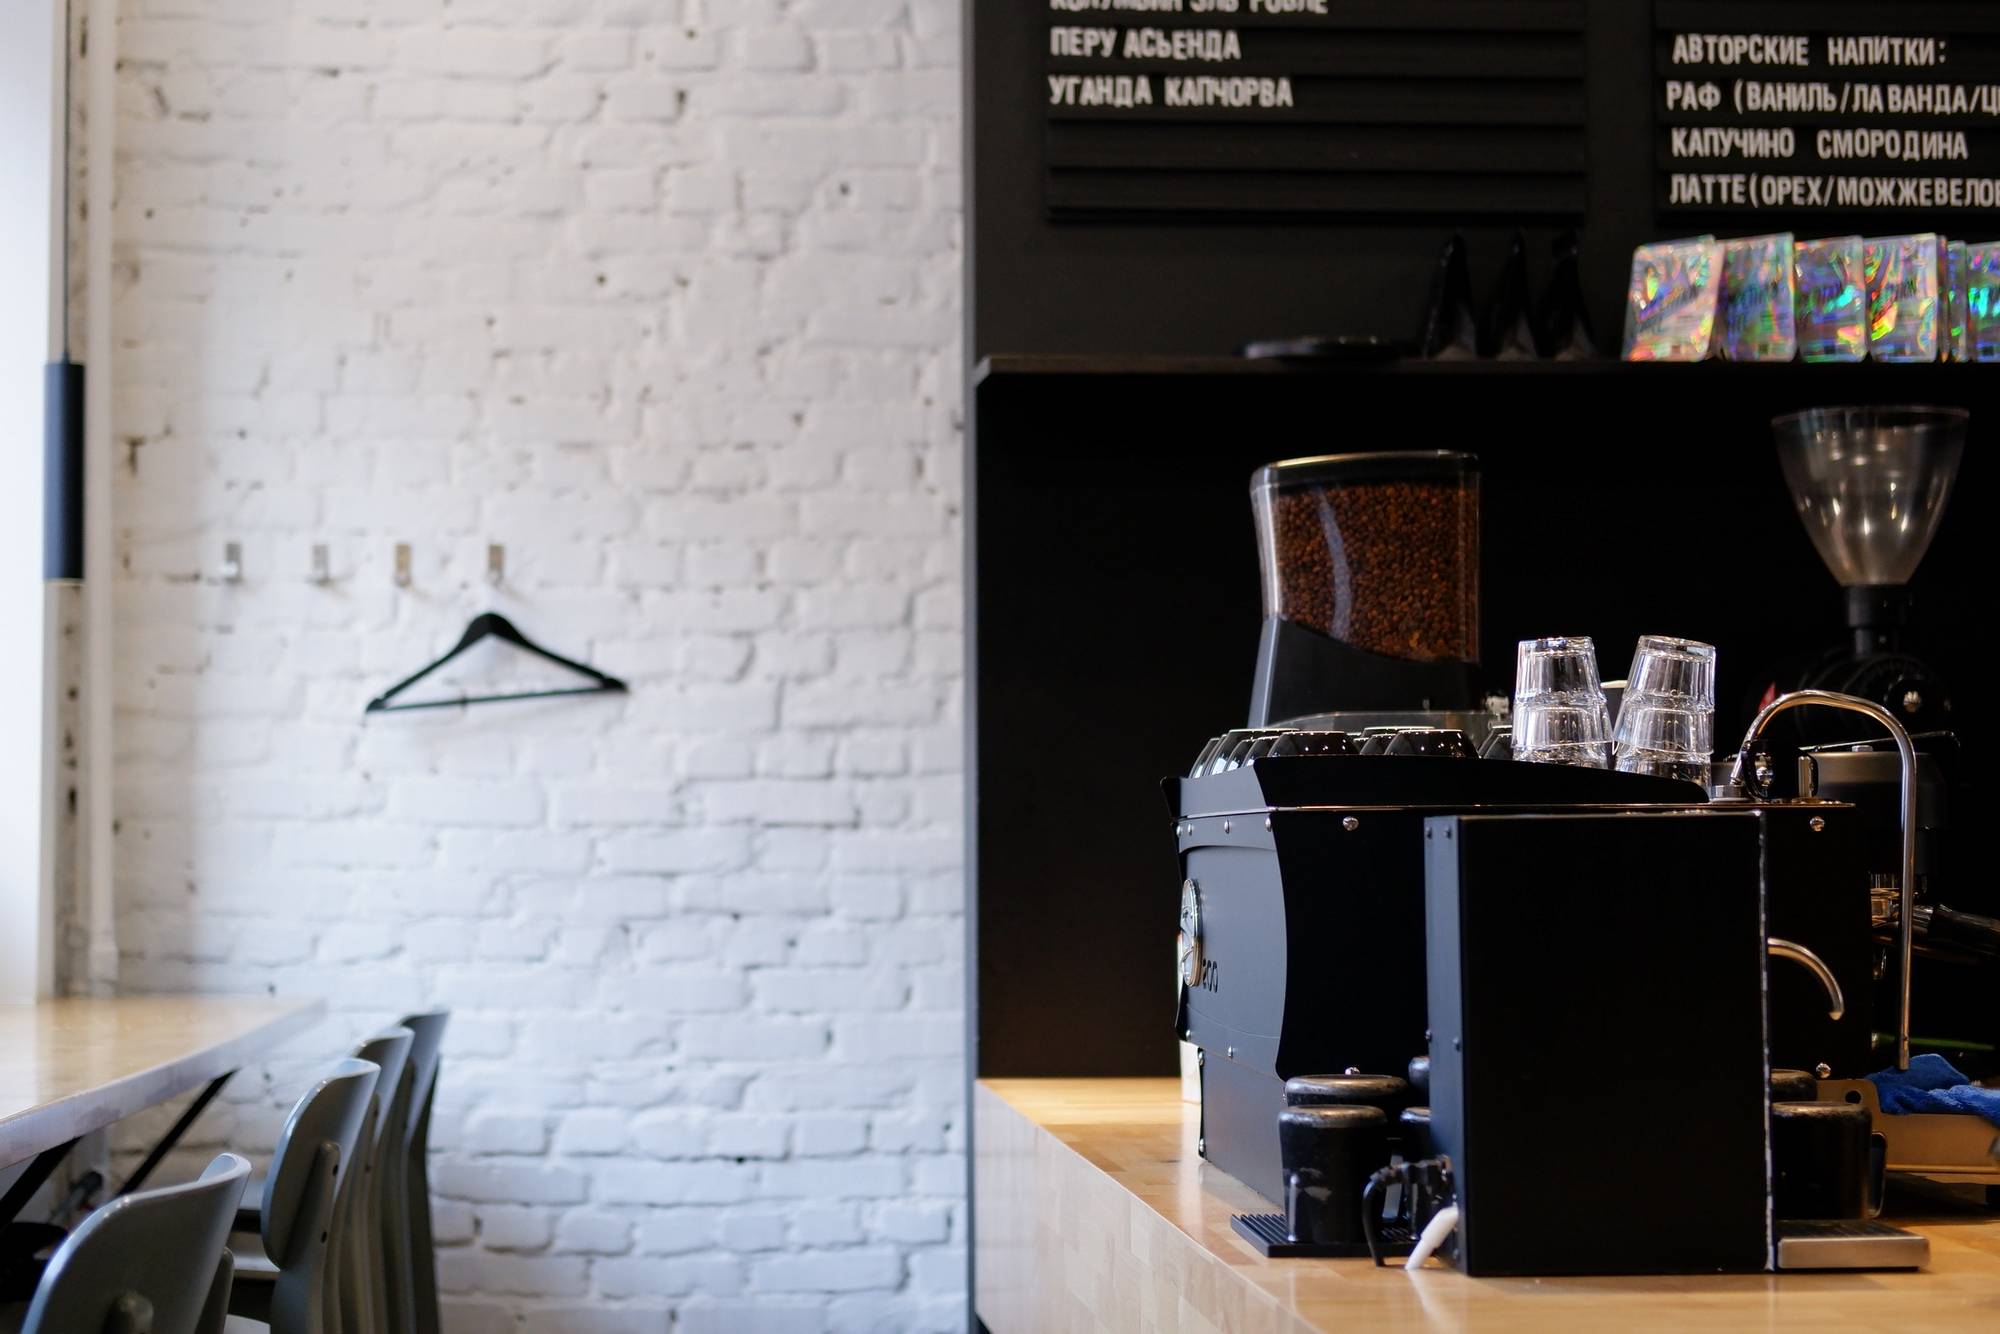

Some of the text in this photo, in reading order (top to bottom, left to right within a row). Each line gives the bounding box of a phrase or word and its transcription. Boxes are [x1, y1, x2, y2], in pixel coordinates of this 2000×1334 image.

[1050, 26, 1242, 61] ПЕРУ АСЬЕНДА
[1672, 34, 1946, 66] АВТОРСКИЕ НАПИТКИ:
[1048, 75, 1294, 108] УГАНДА КАПЧОРВА
[1666, 79, 2000, 116] РАФ (ВАНИЛЬ/ЛАВАНДА/Ц
[1671, 127, 1968, 161] КАПУЧИНО СМОРОДИНА
